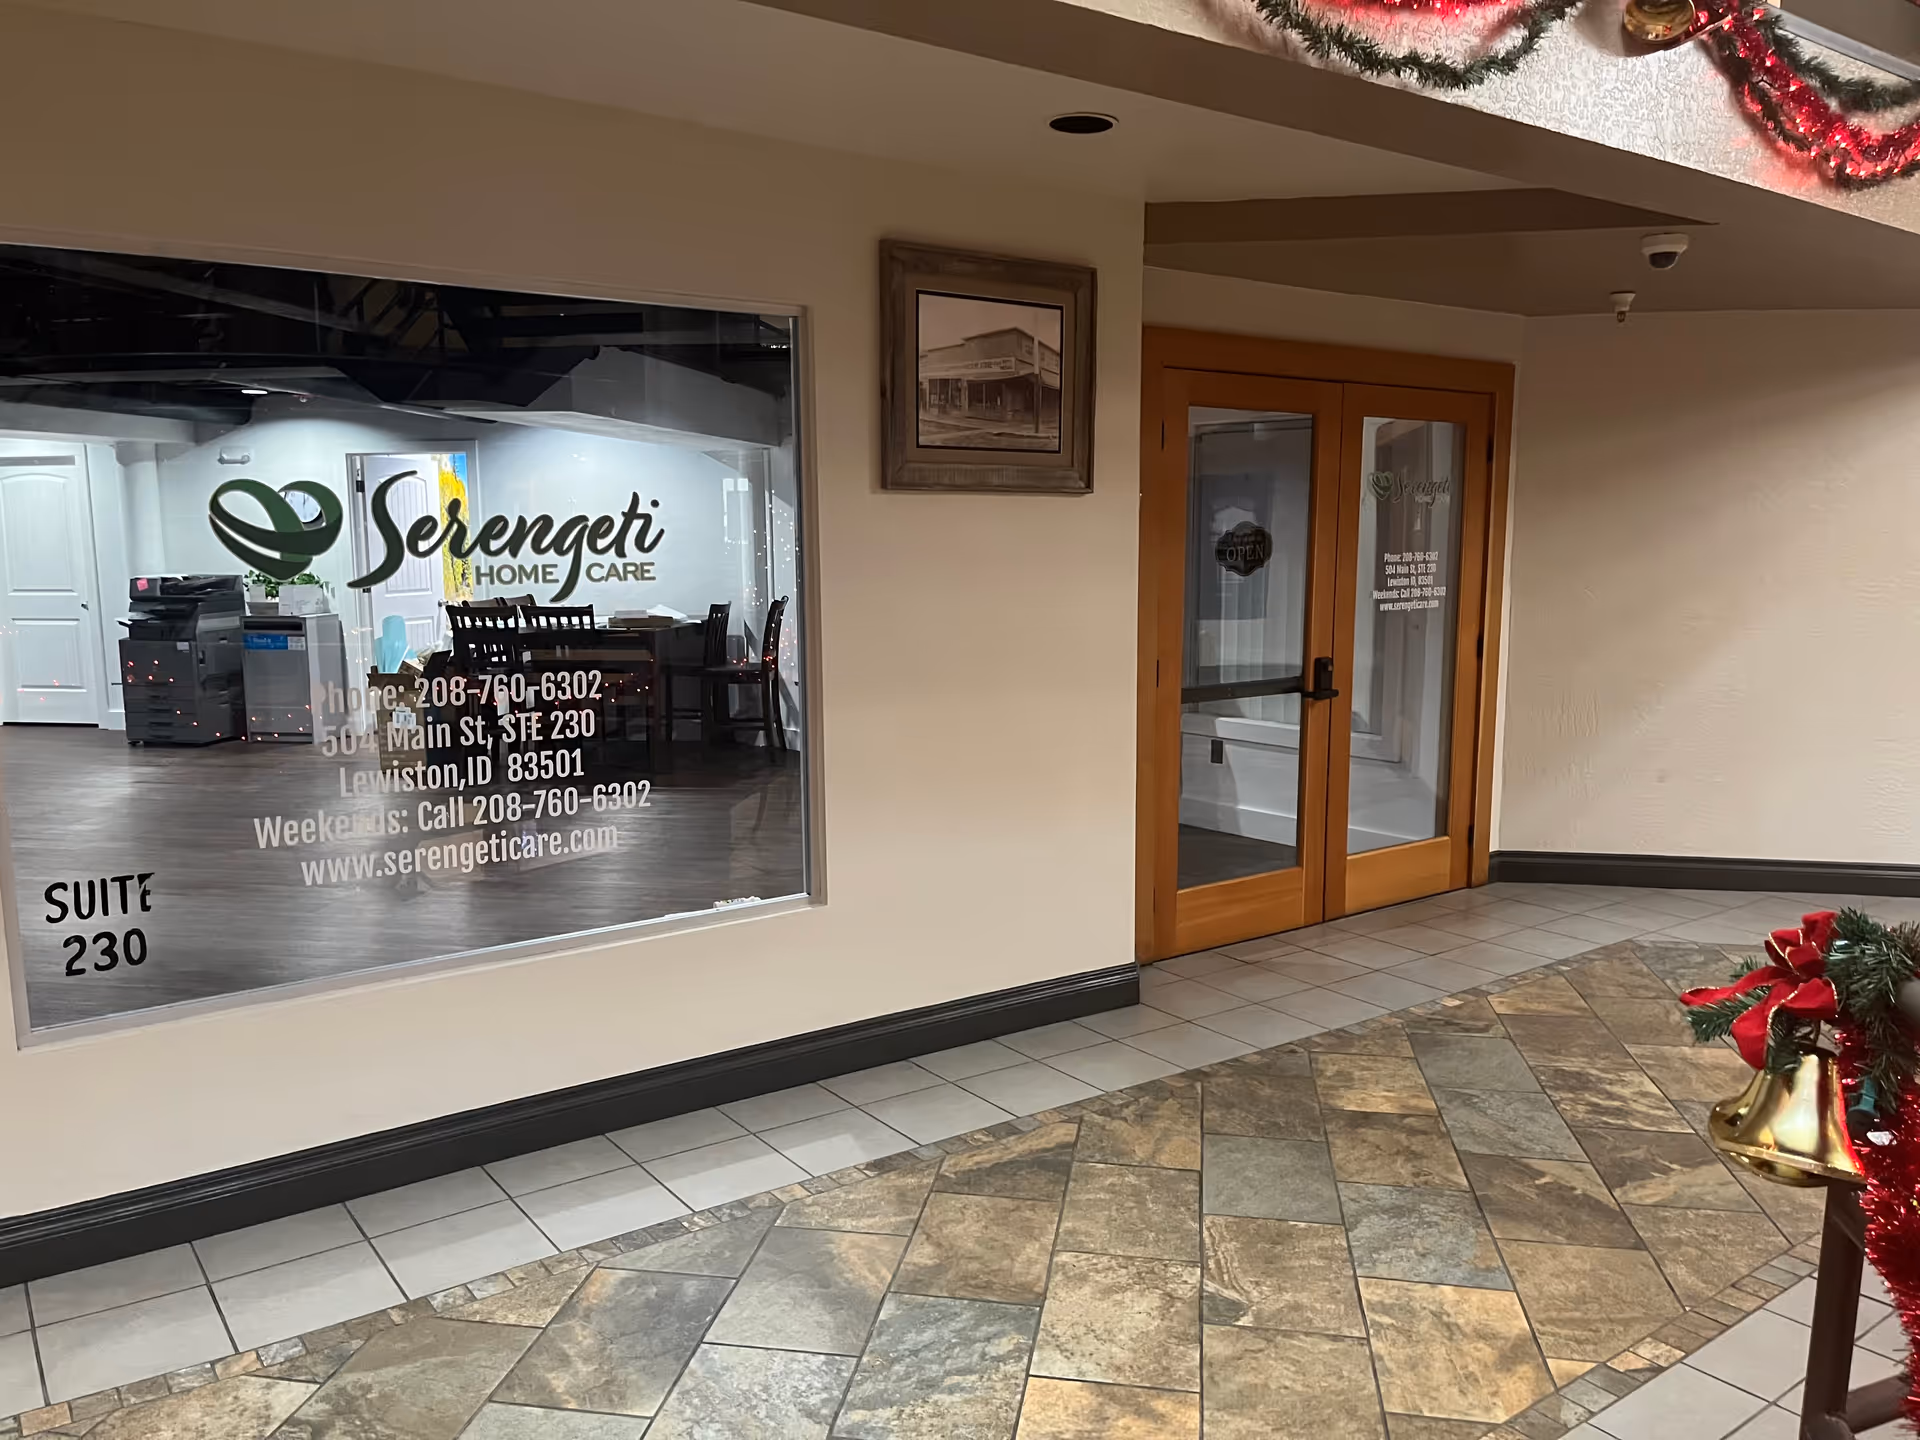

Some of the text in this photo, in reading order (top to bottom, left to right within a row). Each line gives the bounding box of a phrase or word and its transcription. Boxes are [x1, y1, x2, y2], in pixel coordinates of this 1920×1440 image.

[347, 469, 665, 603] Serengeti
[1226, 545, 1265, 561] OPEN
[475, 562, 657, 586] HOME CARE
[1384, 552, 1401, 563] Phone:
[1385, 565, 1396, 575] 504
[1396, 564, 1409, 574] Main
[1373, 588, 1400, 600] Weekends:
[1400, 587, 1410, 599] Call
[1387, 576, 1410, 587] Lewiston
[1418, 575, 1433, 586] 83501
[312, 669, 602, 715] Phone: 208-760-6302
[321, 721, 378, 757] 504
[387, 715, 451, 752] Main
[459, 714, 493, 750] St,
[502, 711, 543, 743] STE
[551, 708, 596, 739] 230
[507, 748, 585, 783] 83501
[253, 779, 651, 849] Weekends: Call 208-760-6302
[300, 823, 618, 887] www.serengeticare.com
[44, 872, 155, 924] SUITE
[62, 928, 148, 977] 230
